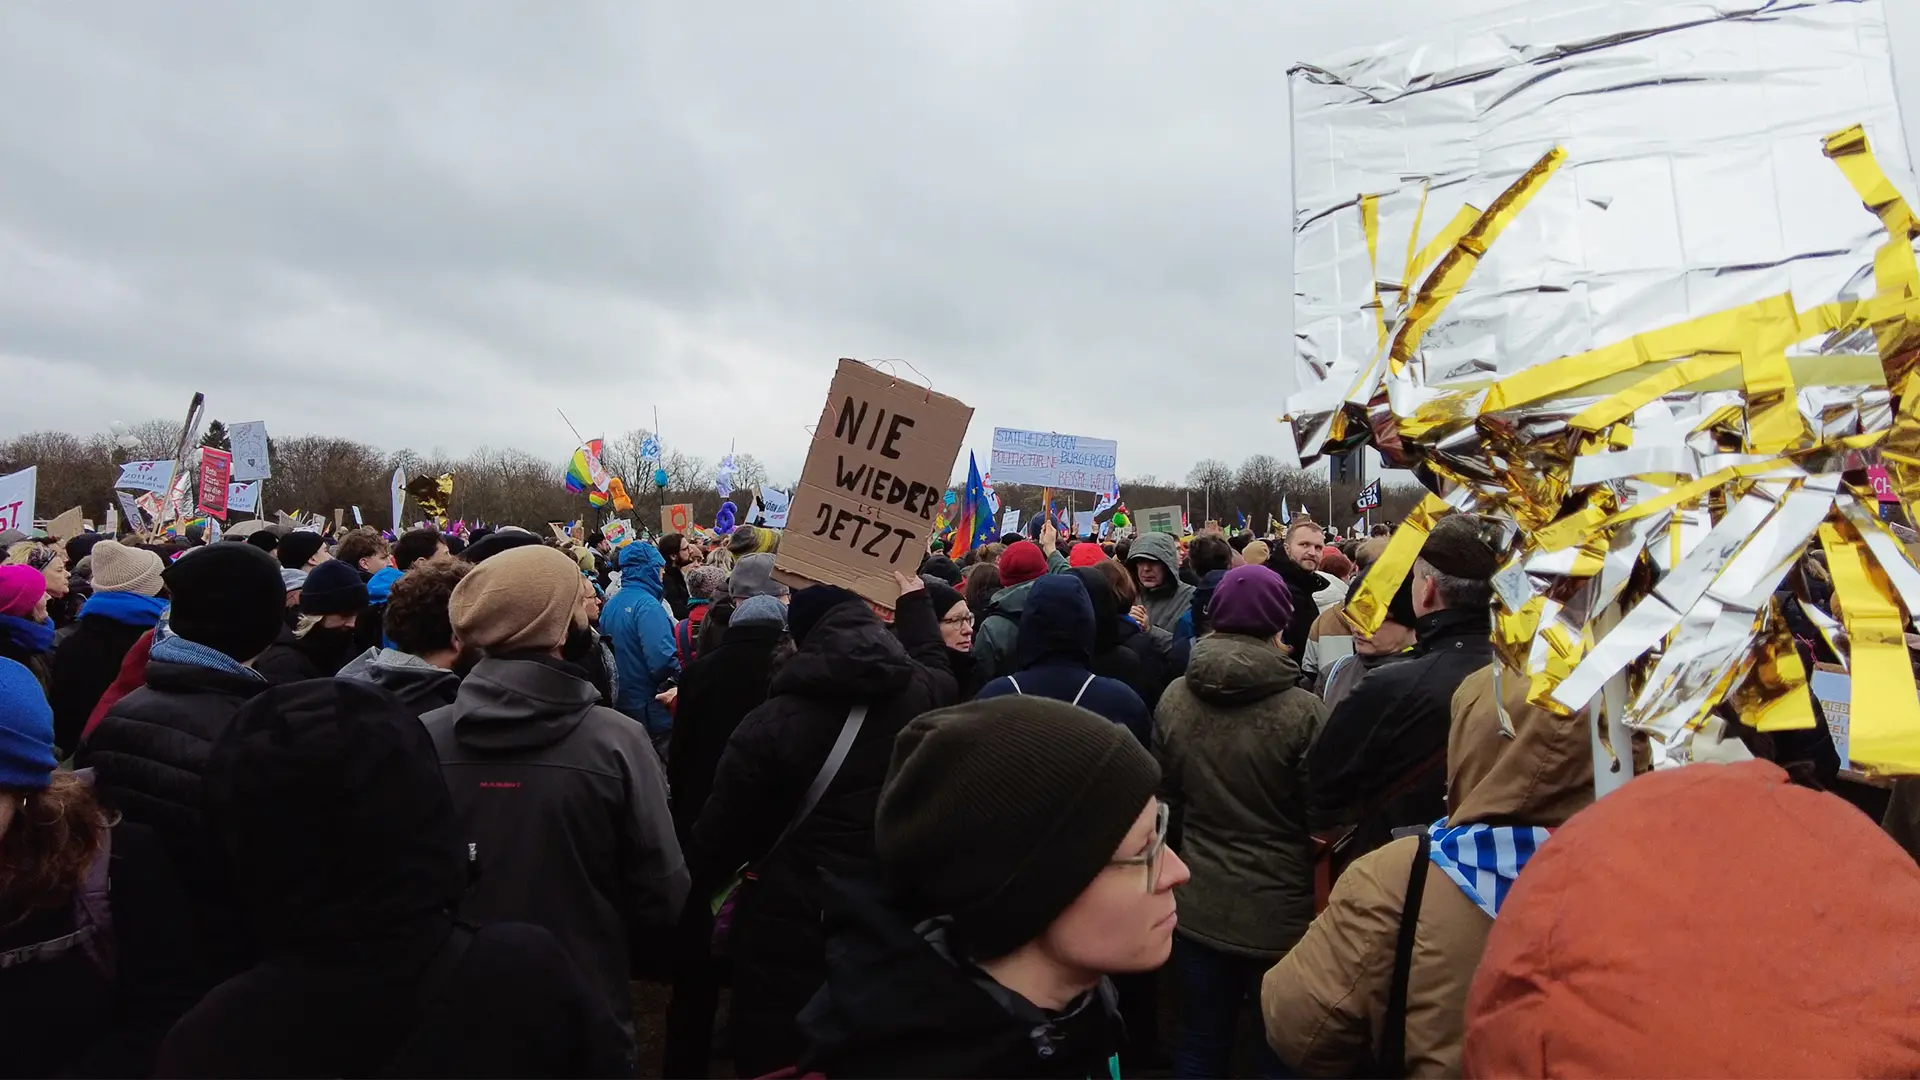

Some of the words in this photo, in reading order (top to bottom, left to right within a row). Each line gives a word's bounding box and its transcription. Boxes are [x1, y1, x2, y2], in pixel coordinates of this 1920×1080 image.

[834, 395, 915, 460] NIE
[993, 449, 1026, 467] POLITIK
[996, 430, 1020, 445] STATT
[1023, 432, 1050, 447] HETZE
[1050, 434, 1077, 450] GEGEN
[836, 455, 940, 521] WIEDER
[812, 502, 916, 564] JETZT
